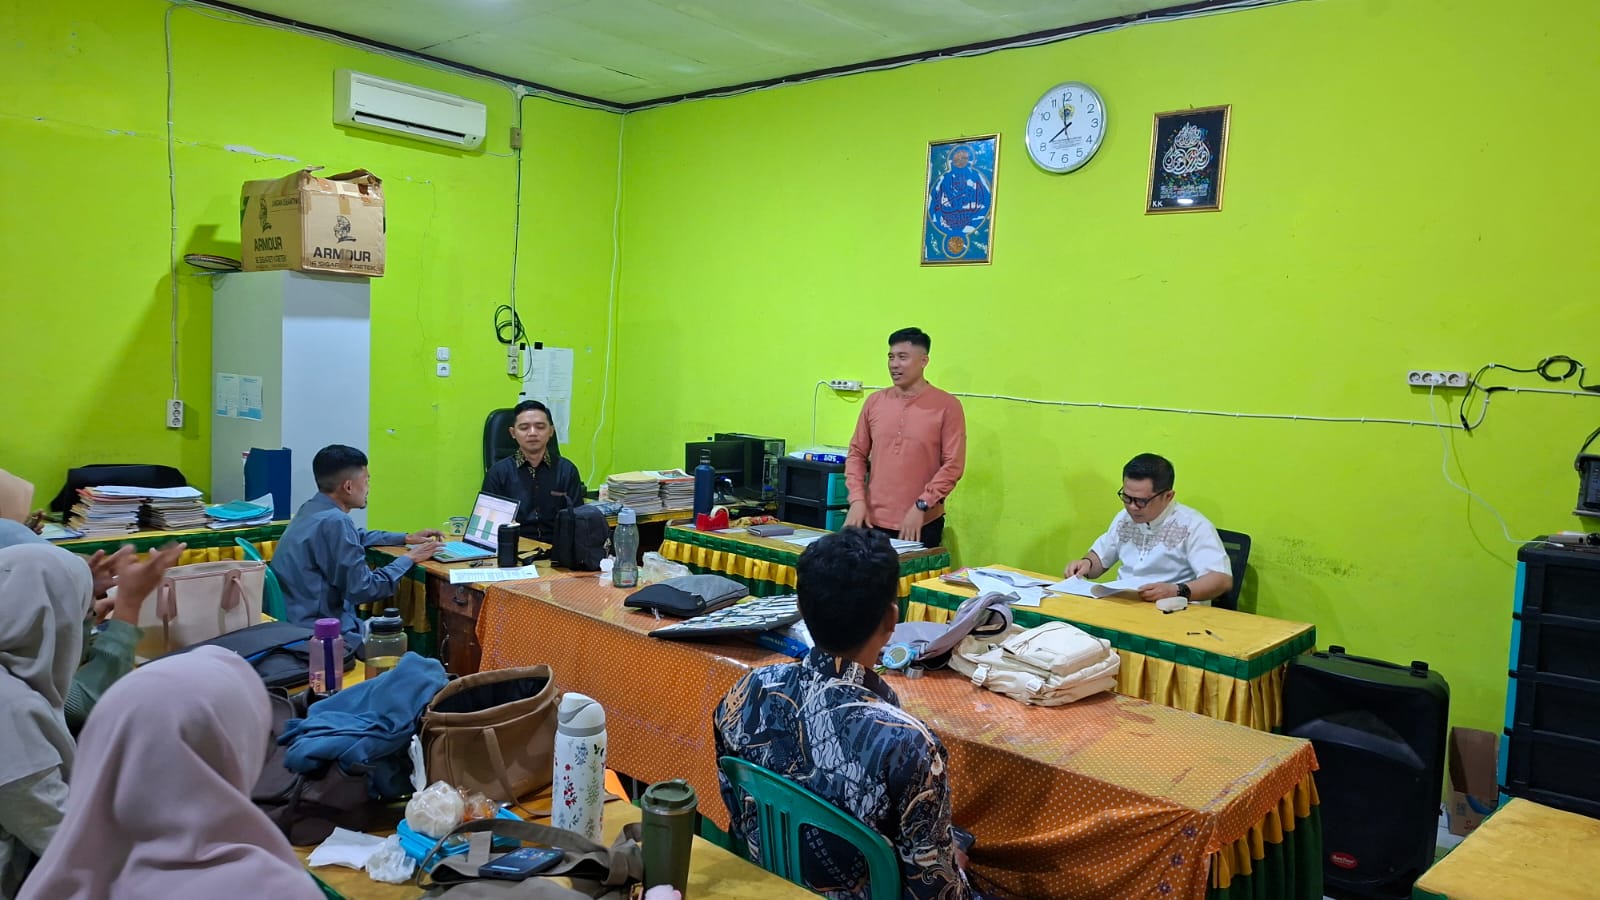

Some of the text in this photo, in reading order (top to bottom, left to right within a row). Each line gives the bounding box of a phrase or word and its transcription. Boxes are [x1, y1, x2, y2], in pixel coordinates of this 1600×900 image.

[1051, 99, 1057, 108] 11
[1087, 103, 1095, 114] 2
[1041, 111, 1051, 121] 10
[1091, 118, 1099, 128] 3
[1035, 127, 1043, 137] 9
[1086, 135, 1093, 144] 4
[1040, 142, 1047, 152] 8
[1050, 152, 1056, 161] 7
[1076, 147, 1084, 158] 5
[1061, 154, 1069, 163] 6
[254, 236, 283, 252] ARMOUR
[313, 246, 371, 262] ARMOUR
